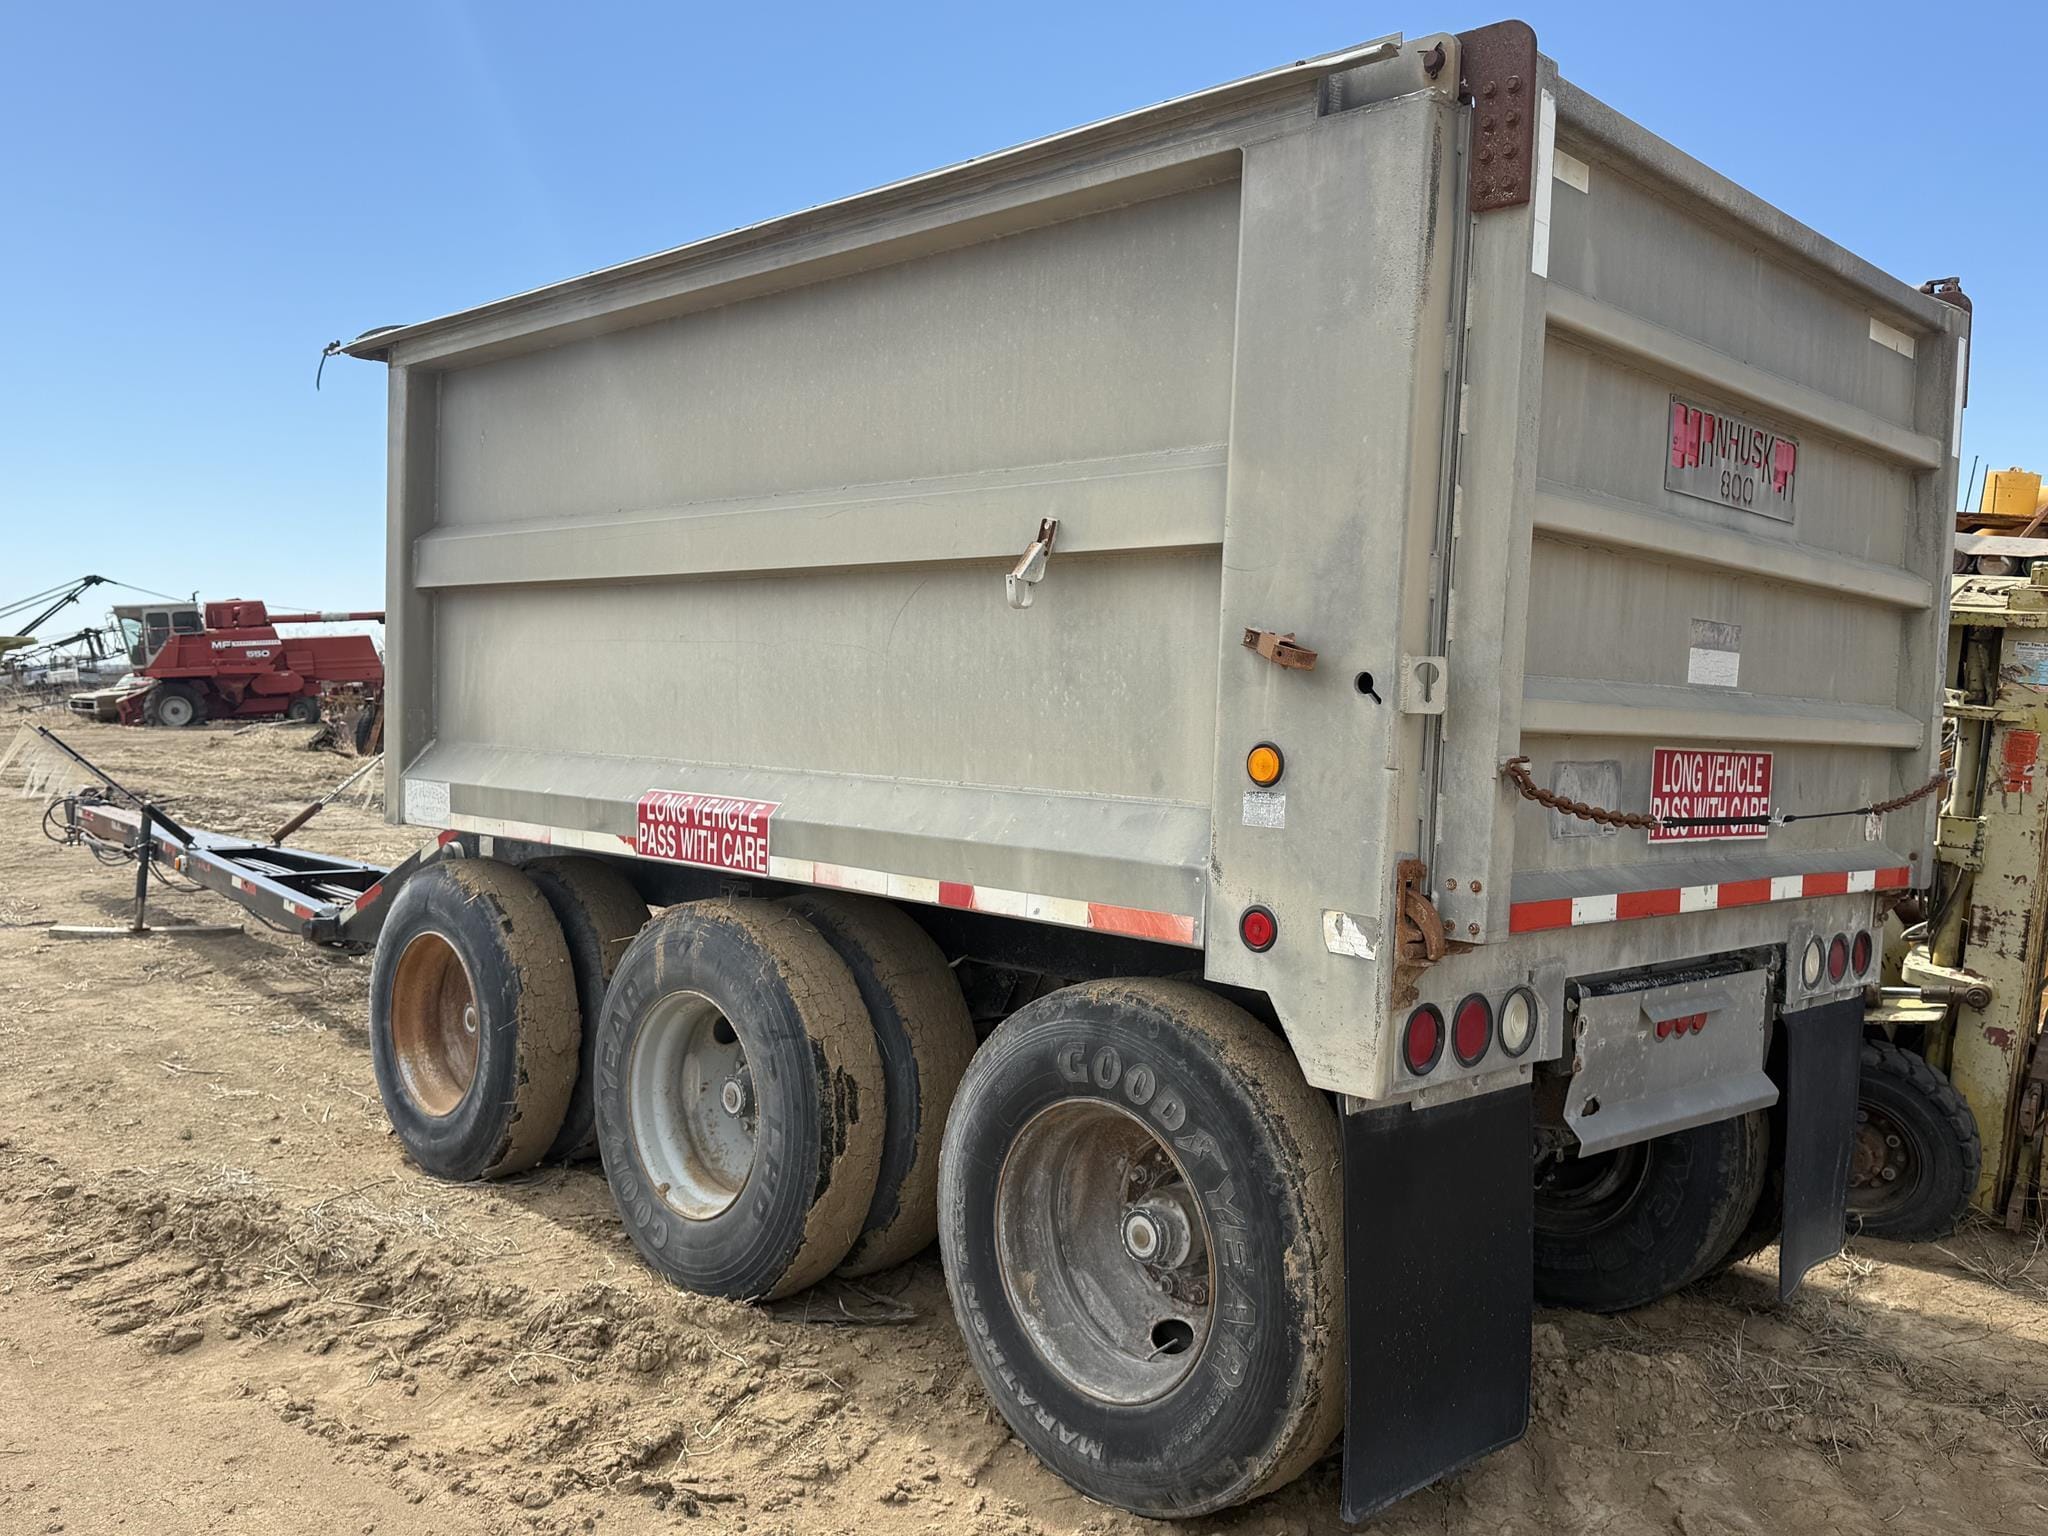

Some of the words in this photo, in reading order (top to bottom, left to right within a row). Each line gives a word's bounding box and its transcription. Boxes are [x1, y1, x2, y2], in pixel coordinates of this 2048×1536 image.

[1720, 469, 1754, 505] 800
[211, 640, 232, 649] MF
[246, 649, 270, 658] 550
[1661, 751, 1703, 794] LONG
[1706, 754, 1764, 794] VEHICLE
[646, 792, 694, 825] LONG
[693, 798, 766, 834] VEHICLE
[1651, 796, 1689, 837] PASS
[1693, 796, 1728, 835] WITH
[1729, 796, 1769, 834] CARE
[639, 822, 677, 858] PASS
[679, 827, 719, 863] WITH
[721, 832, 767, 872] CARE
[1056, 1041, 1259, 1391] GOODYEAR
[963, 1281, 1105, 1461] MARATHON
